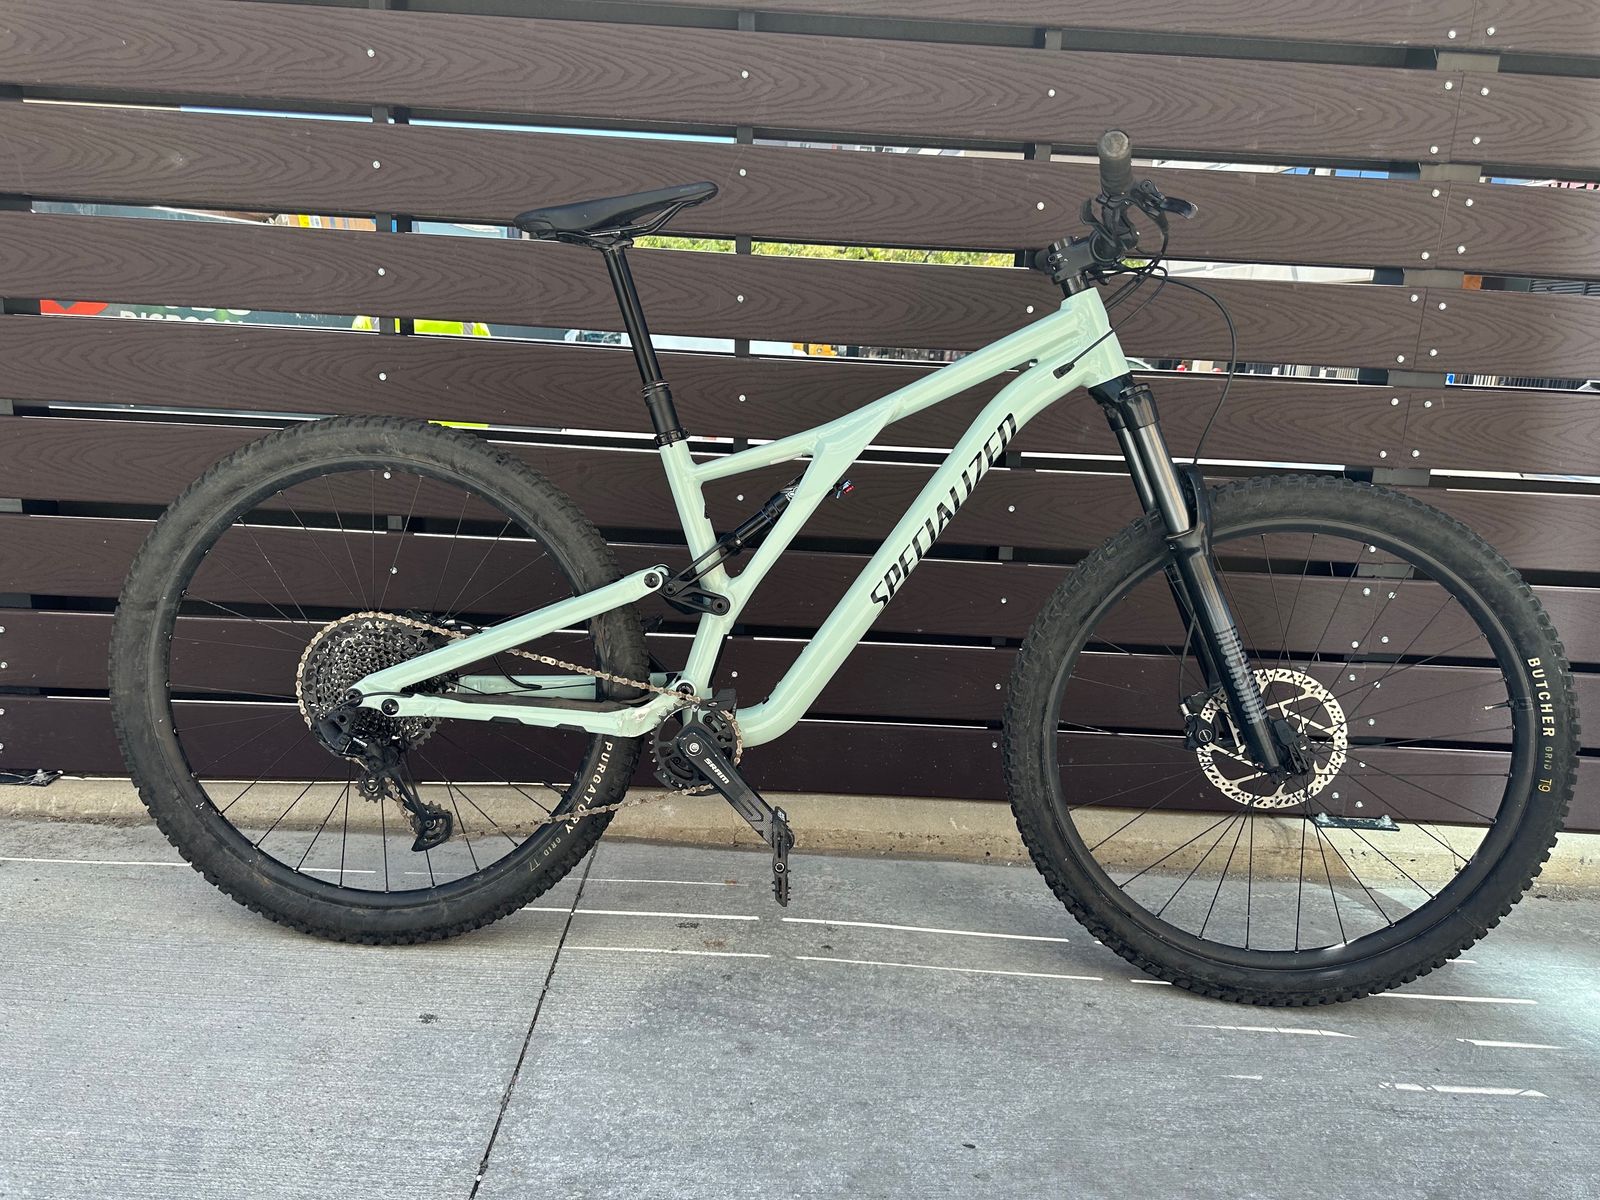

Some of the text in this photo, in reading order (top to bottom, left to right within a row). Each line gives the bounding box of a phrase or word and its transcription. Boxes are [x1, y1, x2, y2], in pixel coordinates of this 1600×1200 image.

[870, 412, 1017, 606] SPECIALIZED
[1214, 626, 1270, 725] ROCKSHOX
[1527, 657, 1555, 793] BUTCHER GRID T9
[528, 741, 614, 872] PURGATORY GRID T7
[703, 757, 730, 784] SRAM
